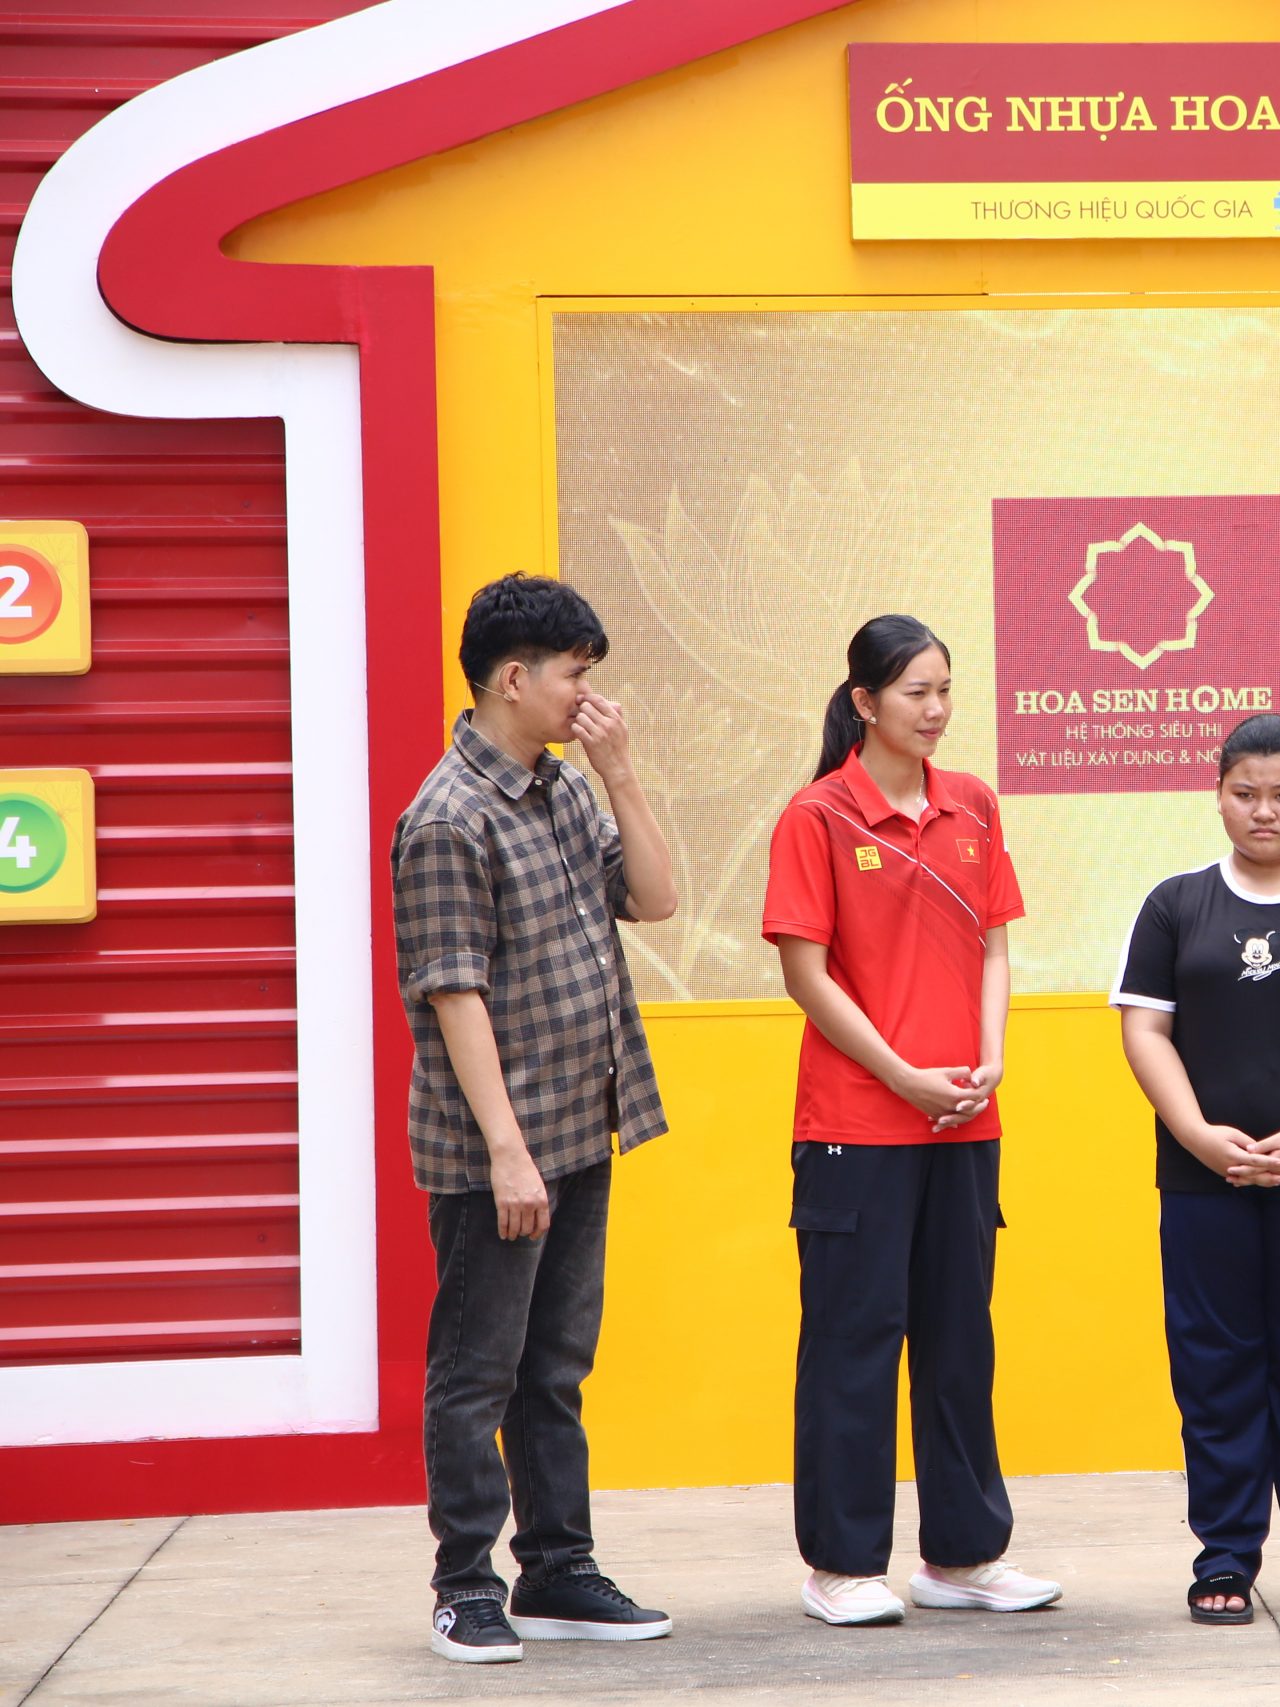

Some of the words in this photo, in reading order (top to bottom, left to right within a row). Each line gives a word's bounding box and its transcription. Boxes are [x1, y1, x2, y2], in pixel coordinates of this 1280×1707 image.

[876, 78, 993, 132] ỐNG
[1006, 91, 1157, 142] NHỰA
[971, 199, 1071, 220] THƯƠNG
[1080, 196, 1127, 223] HIỆU
[1135, 194, 1206, 219] QUỐC
[1213, 199, 1253, 218] GIA
[0, 565, 33, 618] 2
[1014, 690, 1087, 715] HOA
[1092, 689, 1159, 713] SEN
[1165, 685, 1272, 714] HOME
[1066, 721, 1088, 742] HỆ
[1179, 749, 1192, 764] &
[0, 817, 37, 868] 4
